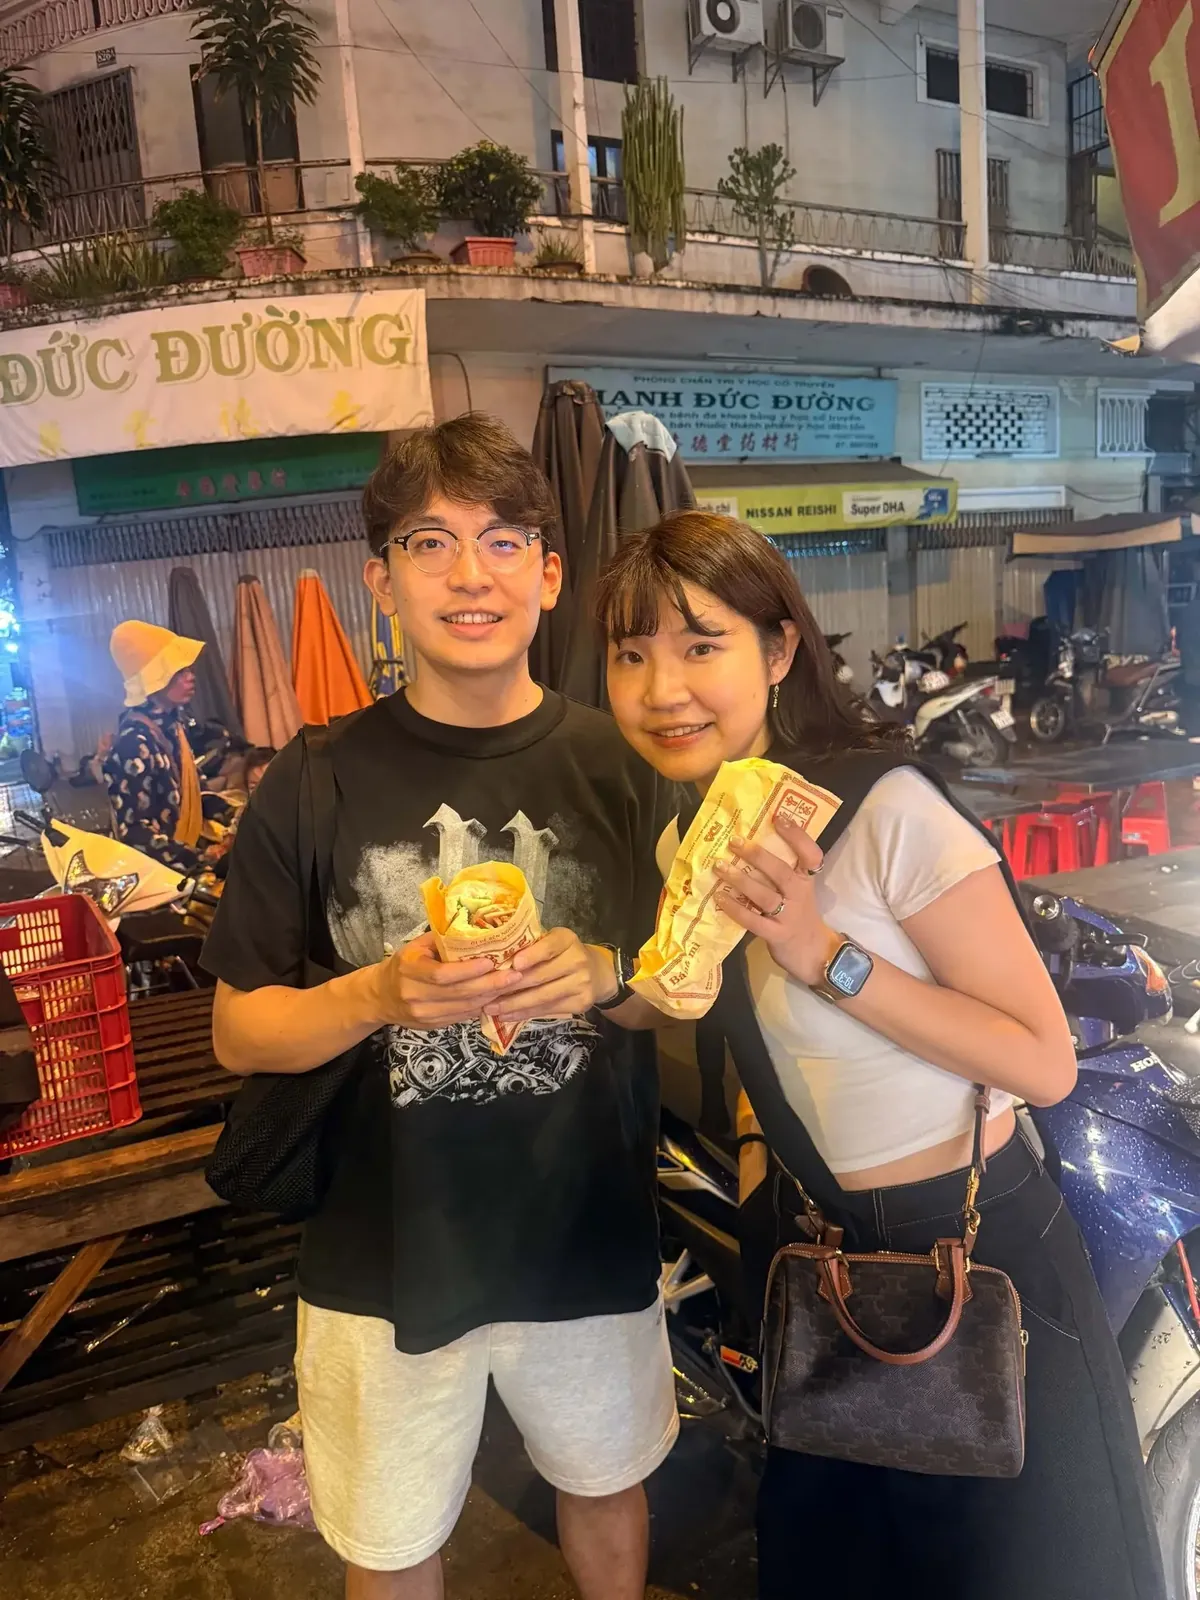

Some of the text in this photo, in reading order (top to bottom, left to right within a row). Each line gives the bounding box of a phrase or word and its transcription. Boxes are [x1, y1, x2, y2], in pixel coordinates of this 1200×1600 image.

[0, 305, 413, 404] ĐỨC ĐƯỜNG
[693, 388, 760, 409] ĐỨC
[771, 391, 876, 412] ĐƯỜNG
[746, 504, 837, 519] NISSAN REISHI
[850, 501, 905, 518] Super DHA
[834, 970, 855, 990] 19:37
